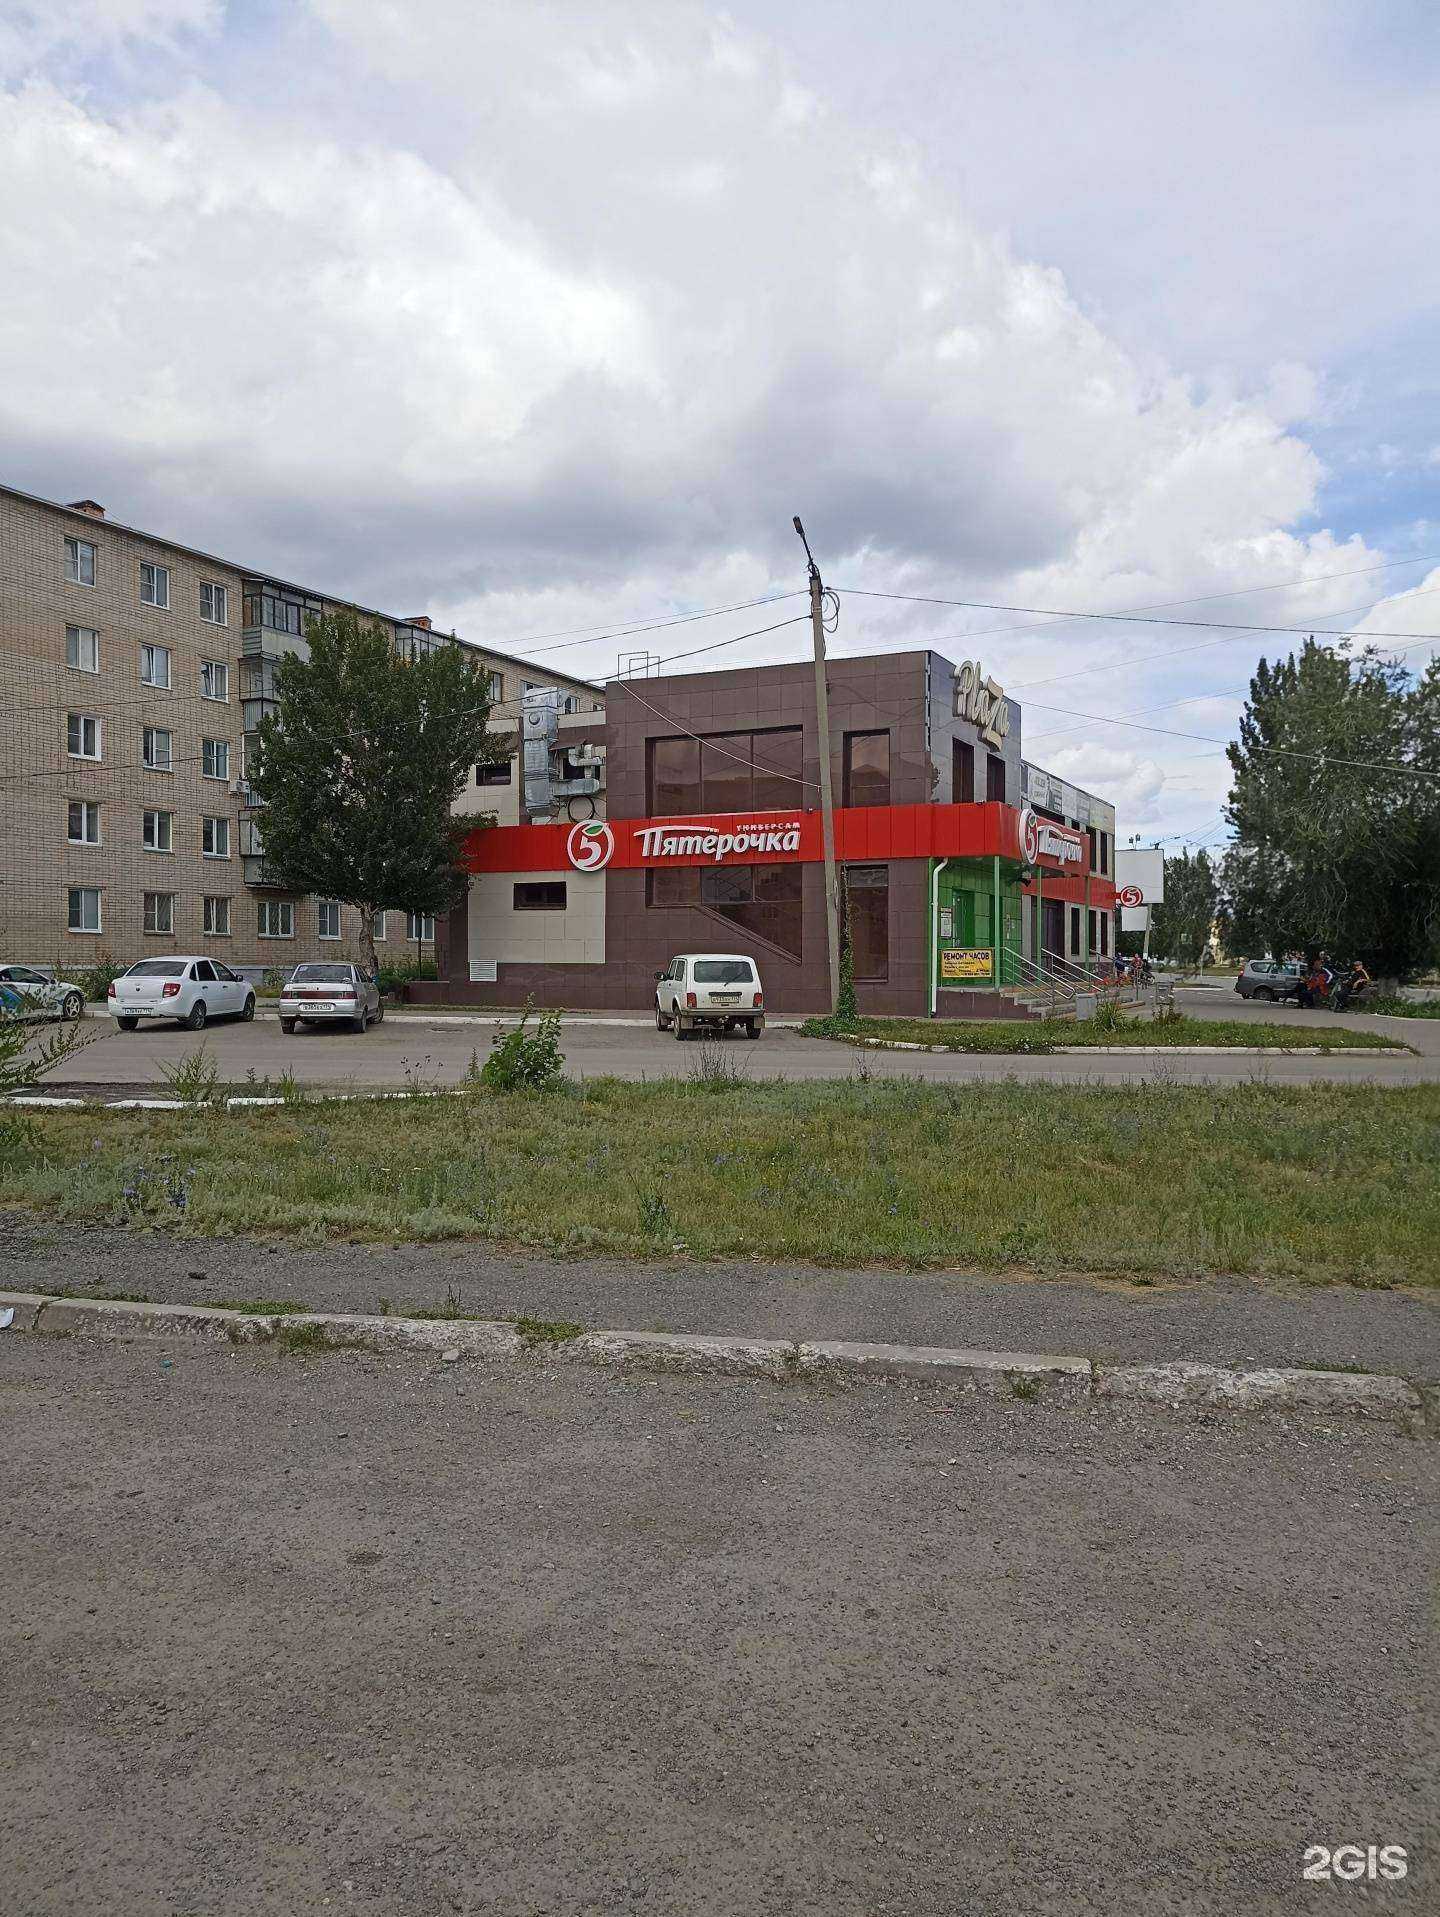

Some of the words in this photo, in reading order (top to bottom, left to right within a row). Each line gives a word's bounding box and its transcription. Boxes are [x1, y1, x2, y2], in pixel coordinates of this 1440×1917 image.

[633, 825, 800, 861] Пятерочка
[943, 952, 968, 960] РЕМОНТ
[969, 951, 990, 960] ЧАСОВ
